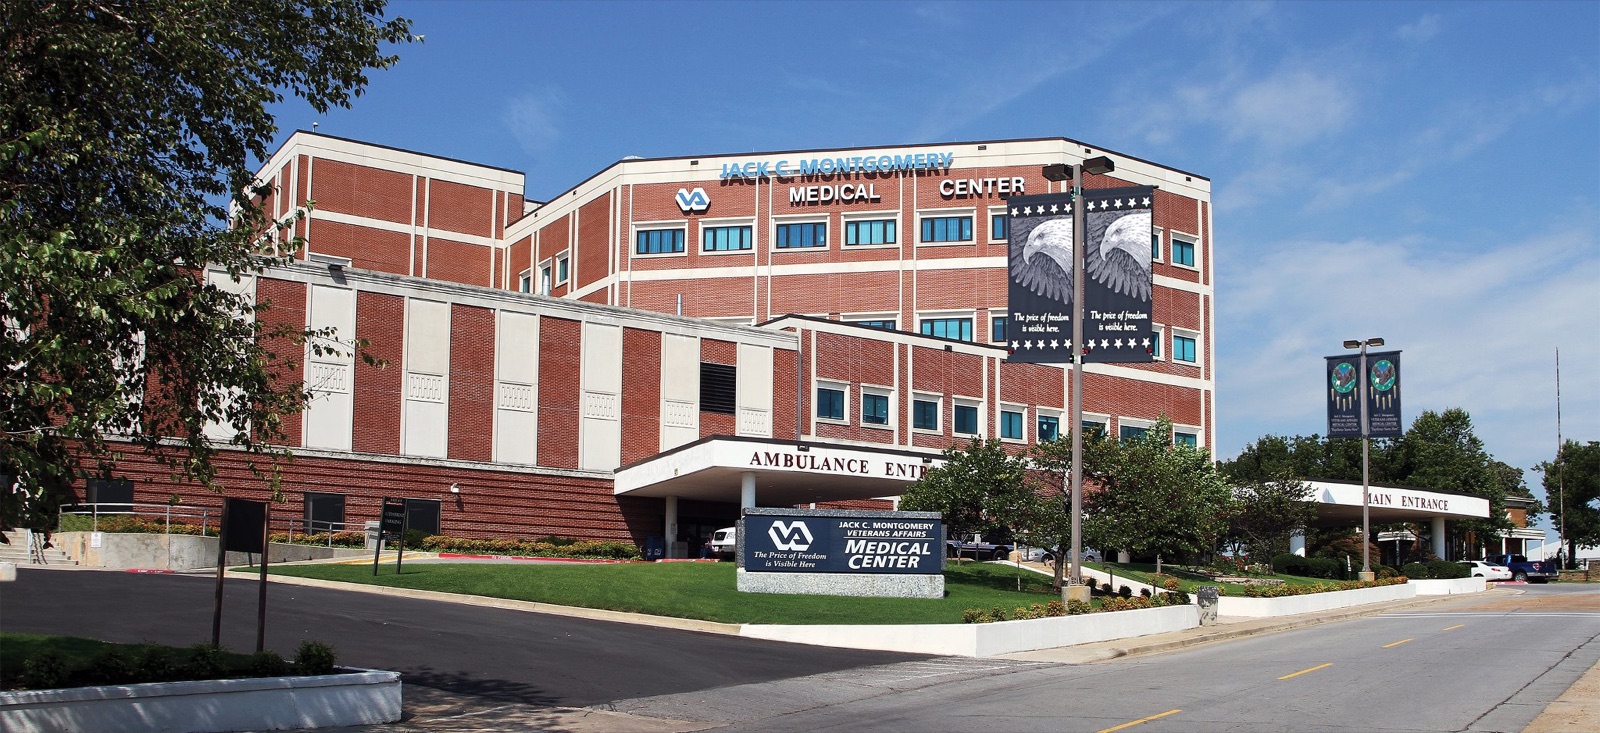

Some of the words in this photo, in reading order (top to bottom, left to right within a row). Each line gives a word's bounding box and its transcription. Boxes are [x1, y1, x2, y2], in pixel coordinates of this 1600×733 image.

[720, 161, 770, 179] JACK
[775, 160, 794, 176] C.
[800, 152, 953, 175] MONTGOMERY
[789, 183, 881, 203] MEDICAL
[940, 176, 1025, 197] CENTER
[675, 187, 711, 212] VA
[1014, 312, 1024, 321] The
[1026, 314, 1038, 322] price
[1040, 312, 1047, 322] of
[1047, 312, 1069, 322] freedom
[1090, 310, 1102, 320] The
[1102, 312, 1116, 321] price
[1118, 310, 1124, 321] of
[1124, 310, 1148, 321] freedom
[1028, 324, 1045, 332] visible
[1046, 324, 1060, 332] here.
[1098, 322, 1104, 331] is
[1105, 322, 1123, 331] visible
[1124, 322, 1138, 331] here.
[750, 452, 870, 474] AMBULANCE
[1402, 495, 1448, 511] ENTRANCE
[872, 522, 934, 530] MONTGOMERY
[768, 520, 814, 551] VA
[844, 540, 931, 556] MEDICAL
[788, 552, 797, 560] of
[848, 555, 920, 570] CENTER
[772, 560, 798, 568] Visible
